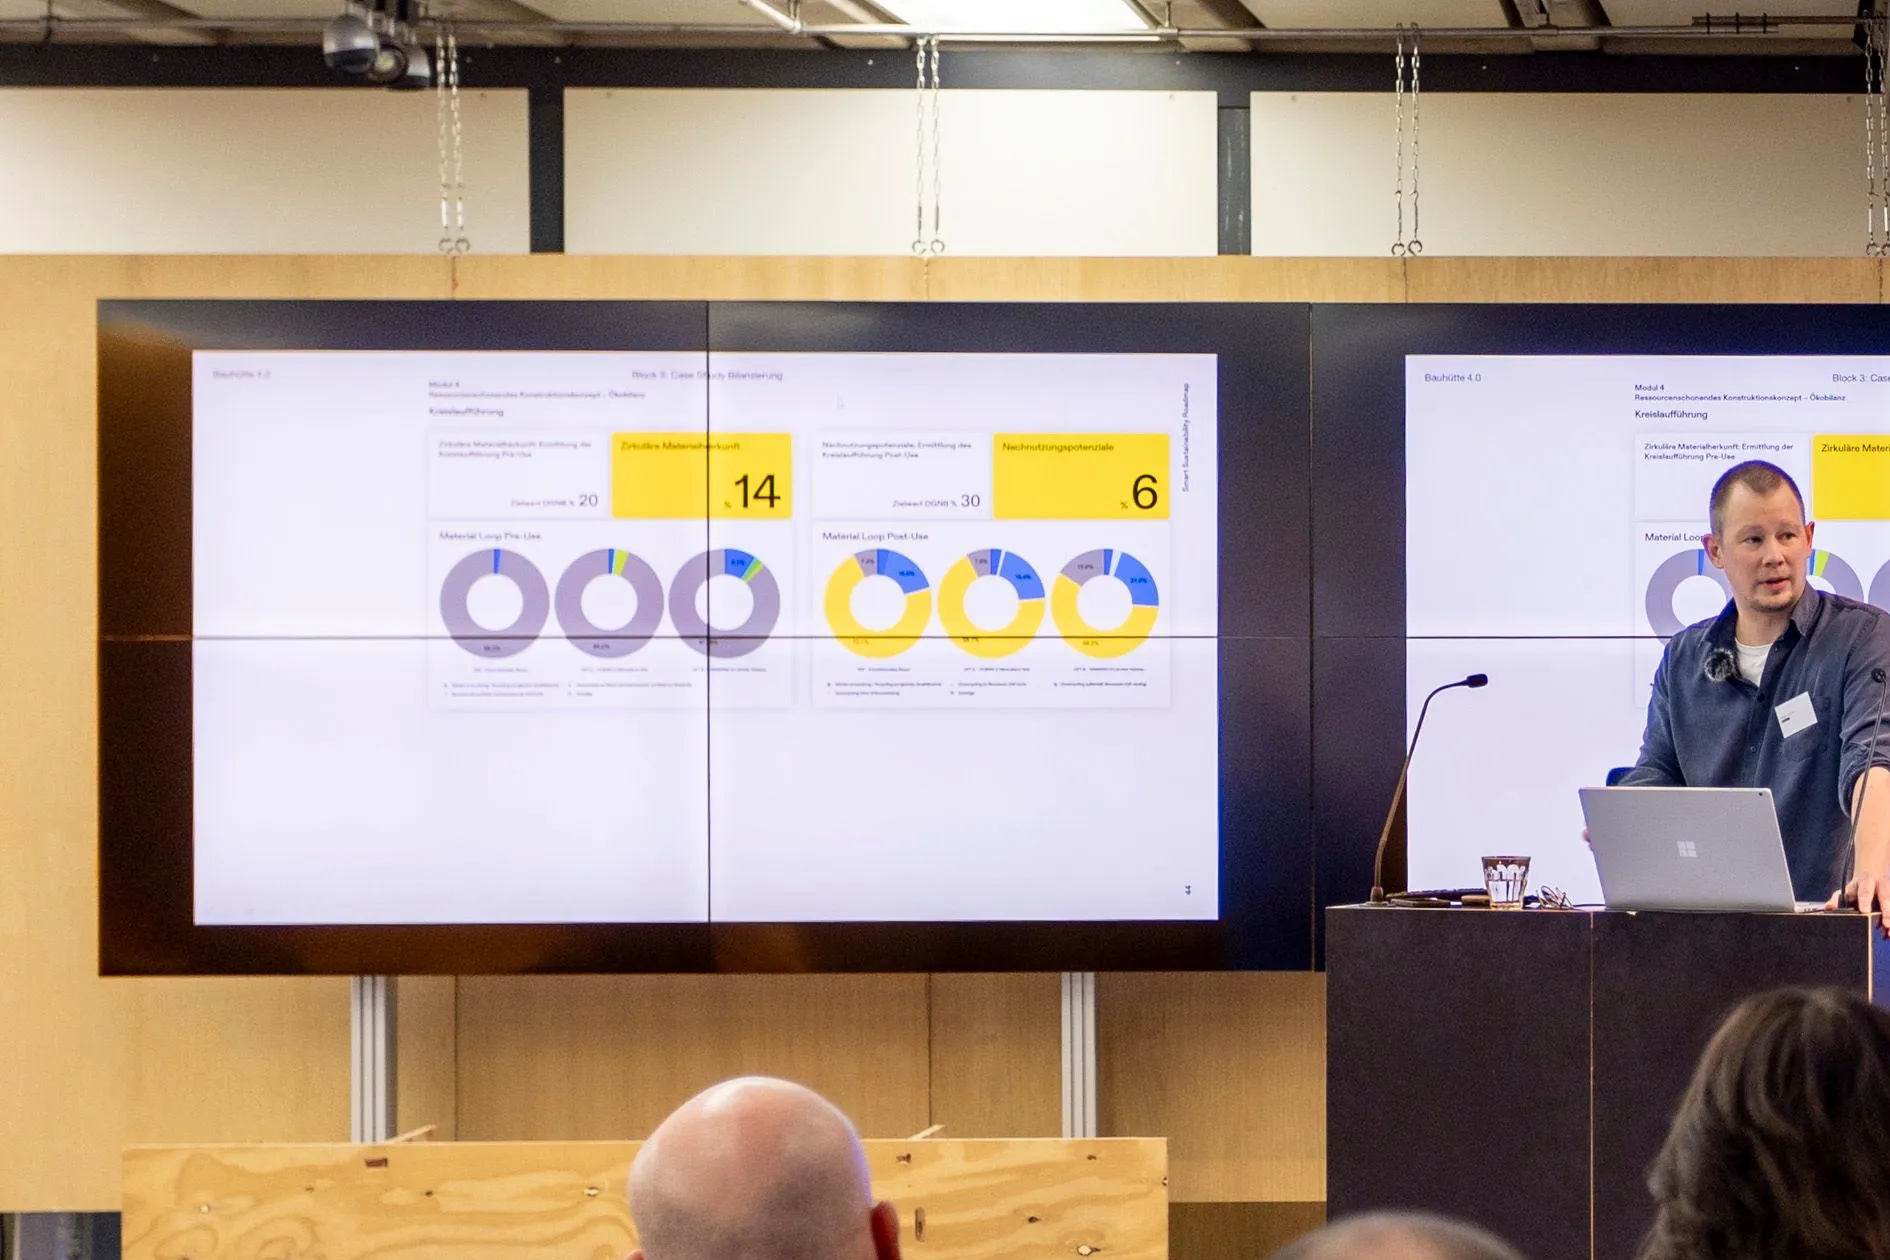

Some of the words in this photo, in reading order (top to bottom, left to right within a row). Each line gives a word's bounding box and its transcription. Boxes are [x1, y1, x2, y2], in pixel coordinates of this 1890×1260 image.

[1424, 373, 1465, 382] Bauhütte
[1467, 373, 1482, 382] 4.0
[1832, 373, 1859, 383] Block
[1860, 373, 1868, 383] 3:
[1635, 384, 1658, 392] Modul
[1659, 384, 1665, 392] 4
[1635, 393, 1721, 401] Ressourcenschonendes
[1723, 393, 1802, 404] Konstruktionskonzept
[1810, 392, 1846, 401] Ökobilanz
[1634, 409, 1708, 420] Kreislaufführung
[1644, 443, 1676, 451] Zirkuläre
[1742, 443, 1780, 451] Ermittlung
[1782, 443, 1794, 451] der
[1821, 443, 1860, 453] Zirkuläre
[1644, 453, 1704, 462] Kreislaufführung
[1706, 453, 1735, 462] Pre-Use
[734, 473, 782, 509] 14
[1132, 473, 1158, 510] 6
[578, 492, 599, 508] 20
[960, 493, 981, 508] 30
[822, 531, 860, 542] Material
[861, 531, 886, 542] Loop
[887, 531, 929, 542] Post-Use
[1644, 532, 1681, 542] Material
